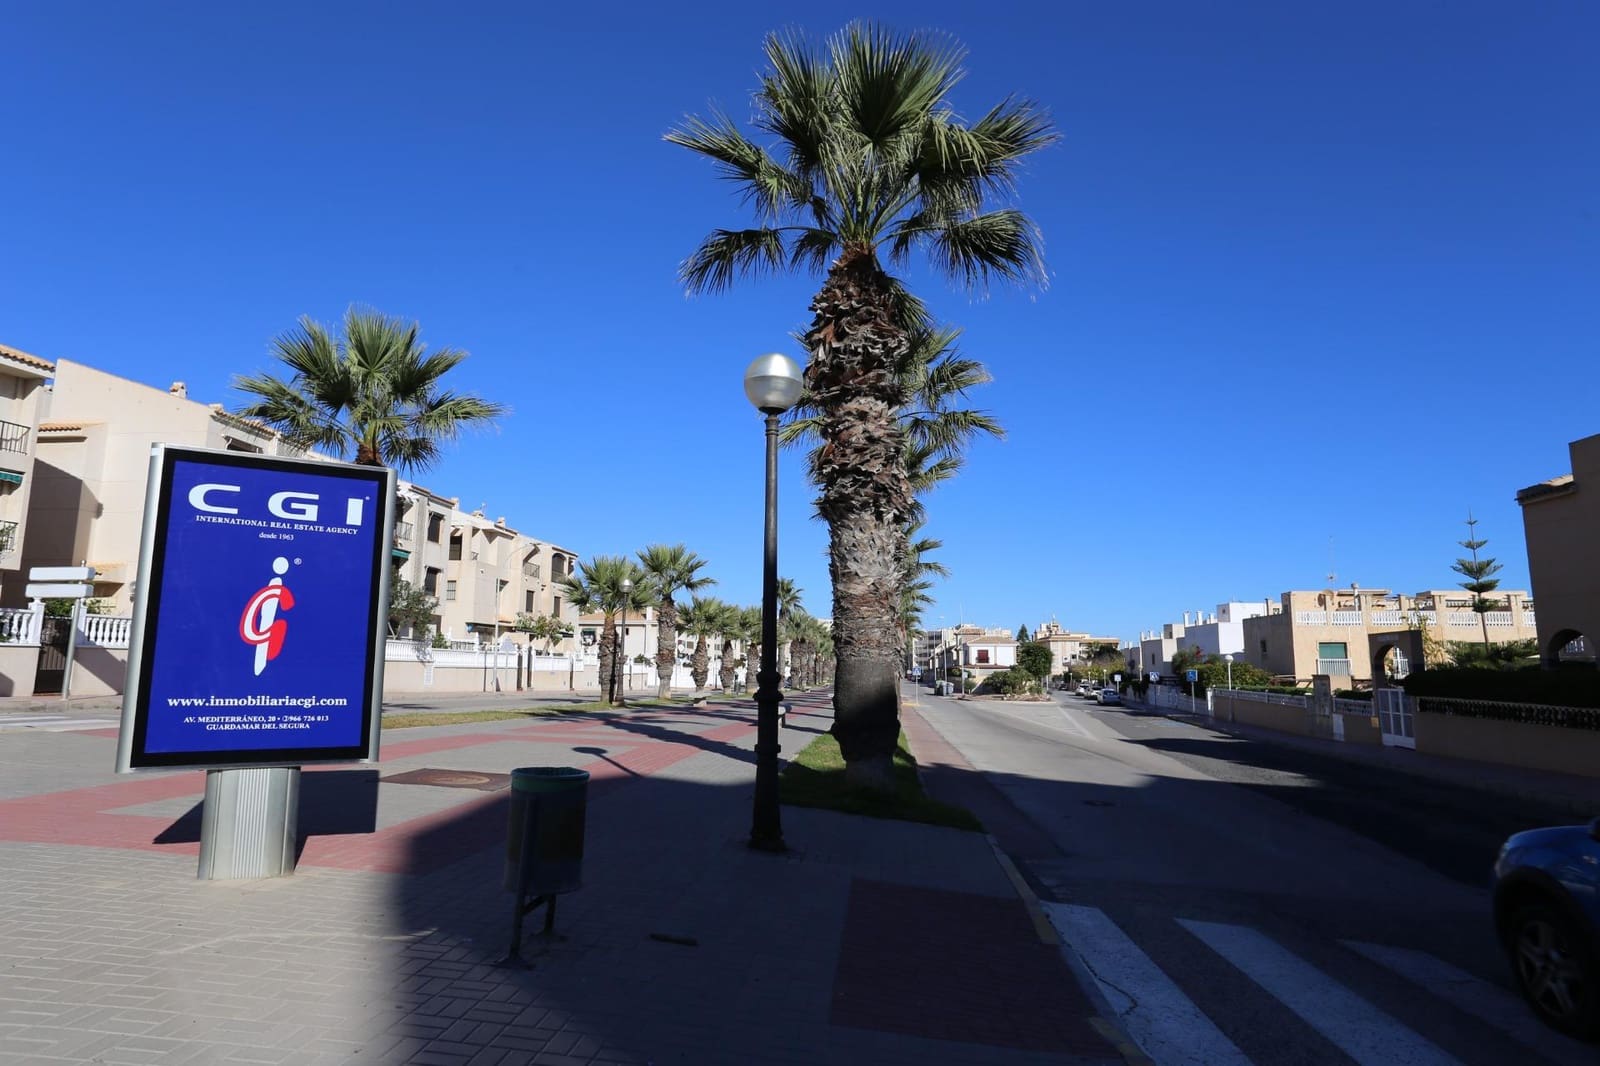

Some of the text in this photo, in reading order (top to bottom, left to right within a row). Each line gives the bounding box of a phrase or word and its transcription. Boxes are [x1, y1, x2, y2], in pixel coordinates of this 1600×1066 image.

[195, 514, 359, 536] INTERNATIONAL REAL ESTATE AGENCY
[258, 531, 295, 542] desde 1963
[167, 695, 348, 709] www.inmobiliariacgi.com
[183, 716, 197, 724] AV.
[198, 714, 267, 724] MEDITERRÁNEO,
[206, 723, 261, 731] GUARDAMAR
[279, 722, 310, 730] SEGURA
